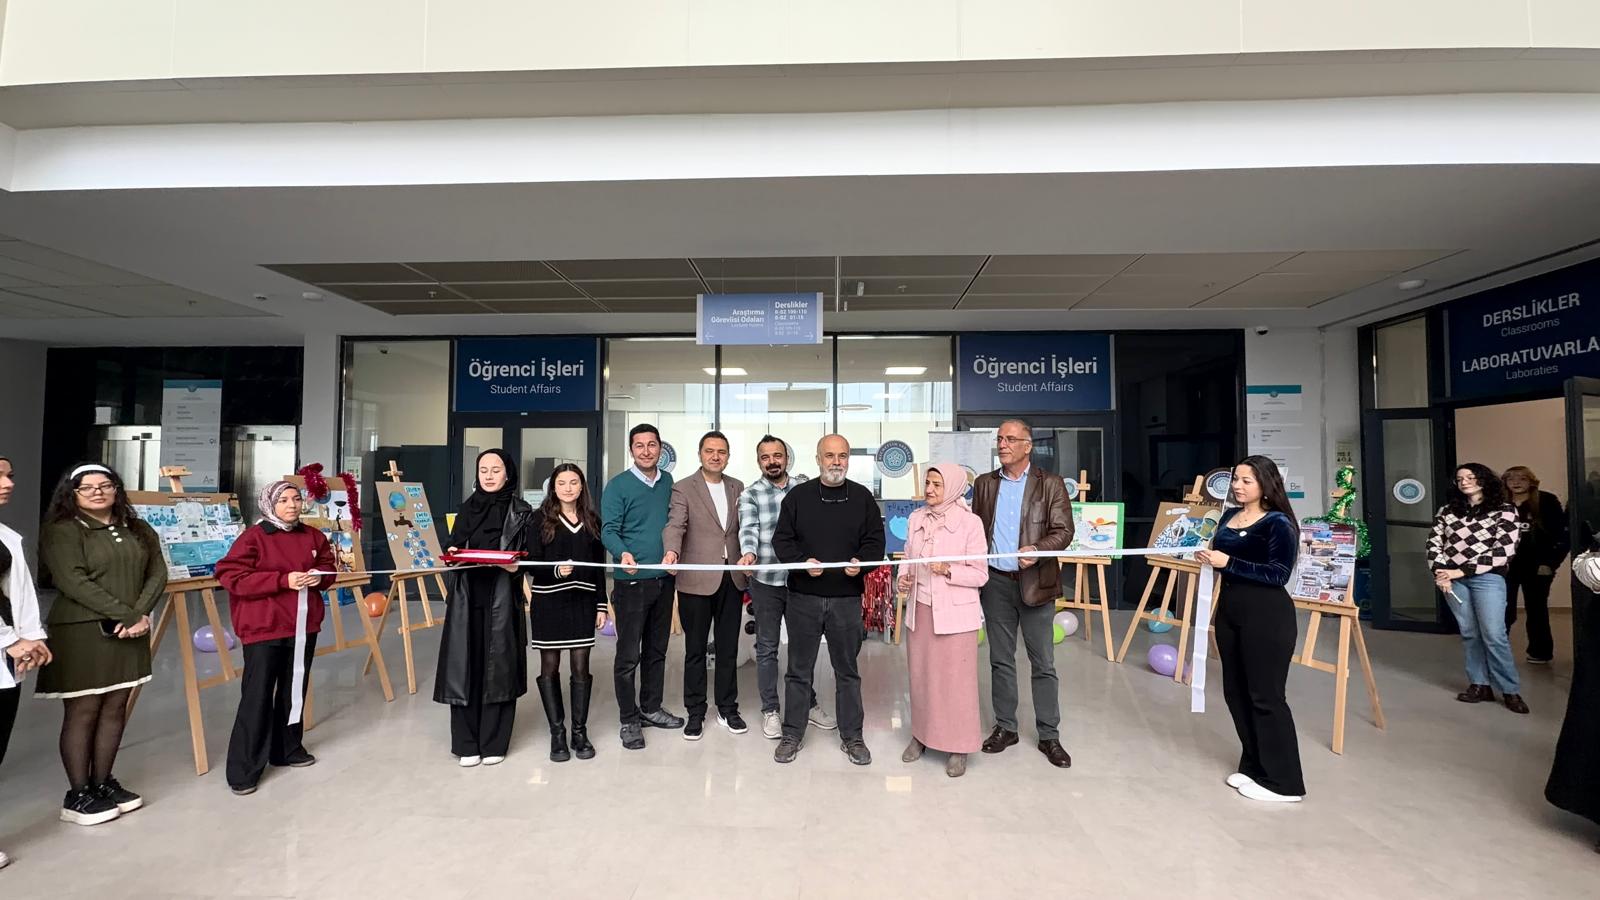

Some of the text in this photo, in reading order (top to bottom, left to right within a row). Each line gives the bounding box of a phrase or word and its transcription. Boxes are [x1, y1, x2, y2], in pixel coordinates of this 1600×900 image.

[732, 309, 765, 317] Araştırma
[1482, 292, 1580, 328] DERSLİKLER
[1501, 318, 1560, 337] Classrooms
[1462, 336, 1600, 373] LABORATUVARLA
[468, 357, 585, 381] Öğrenci İşleri
[973, 354, 1097, 379] Öğrenci İşleri
[1505, 364, 1559, 380] Laboraties
[490, 383, 561, 394] Student Affairs
[997, 381, 1074, 392] Student Affairs
